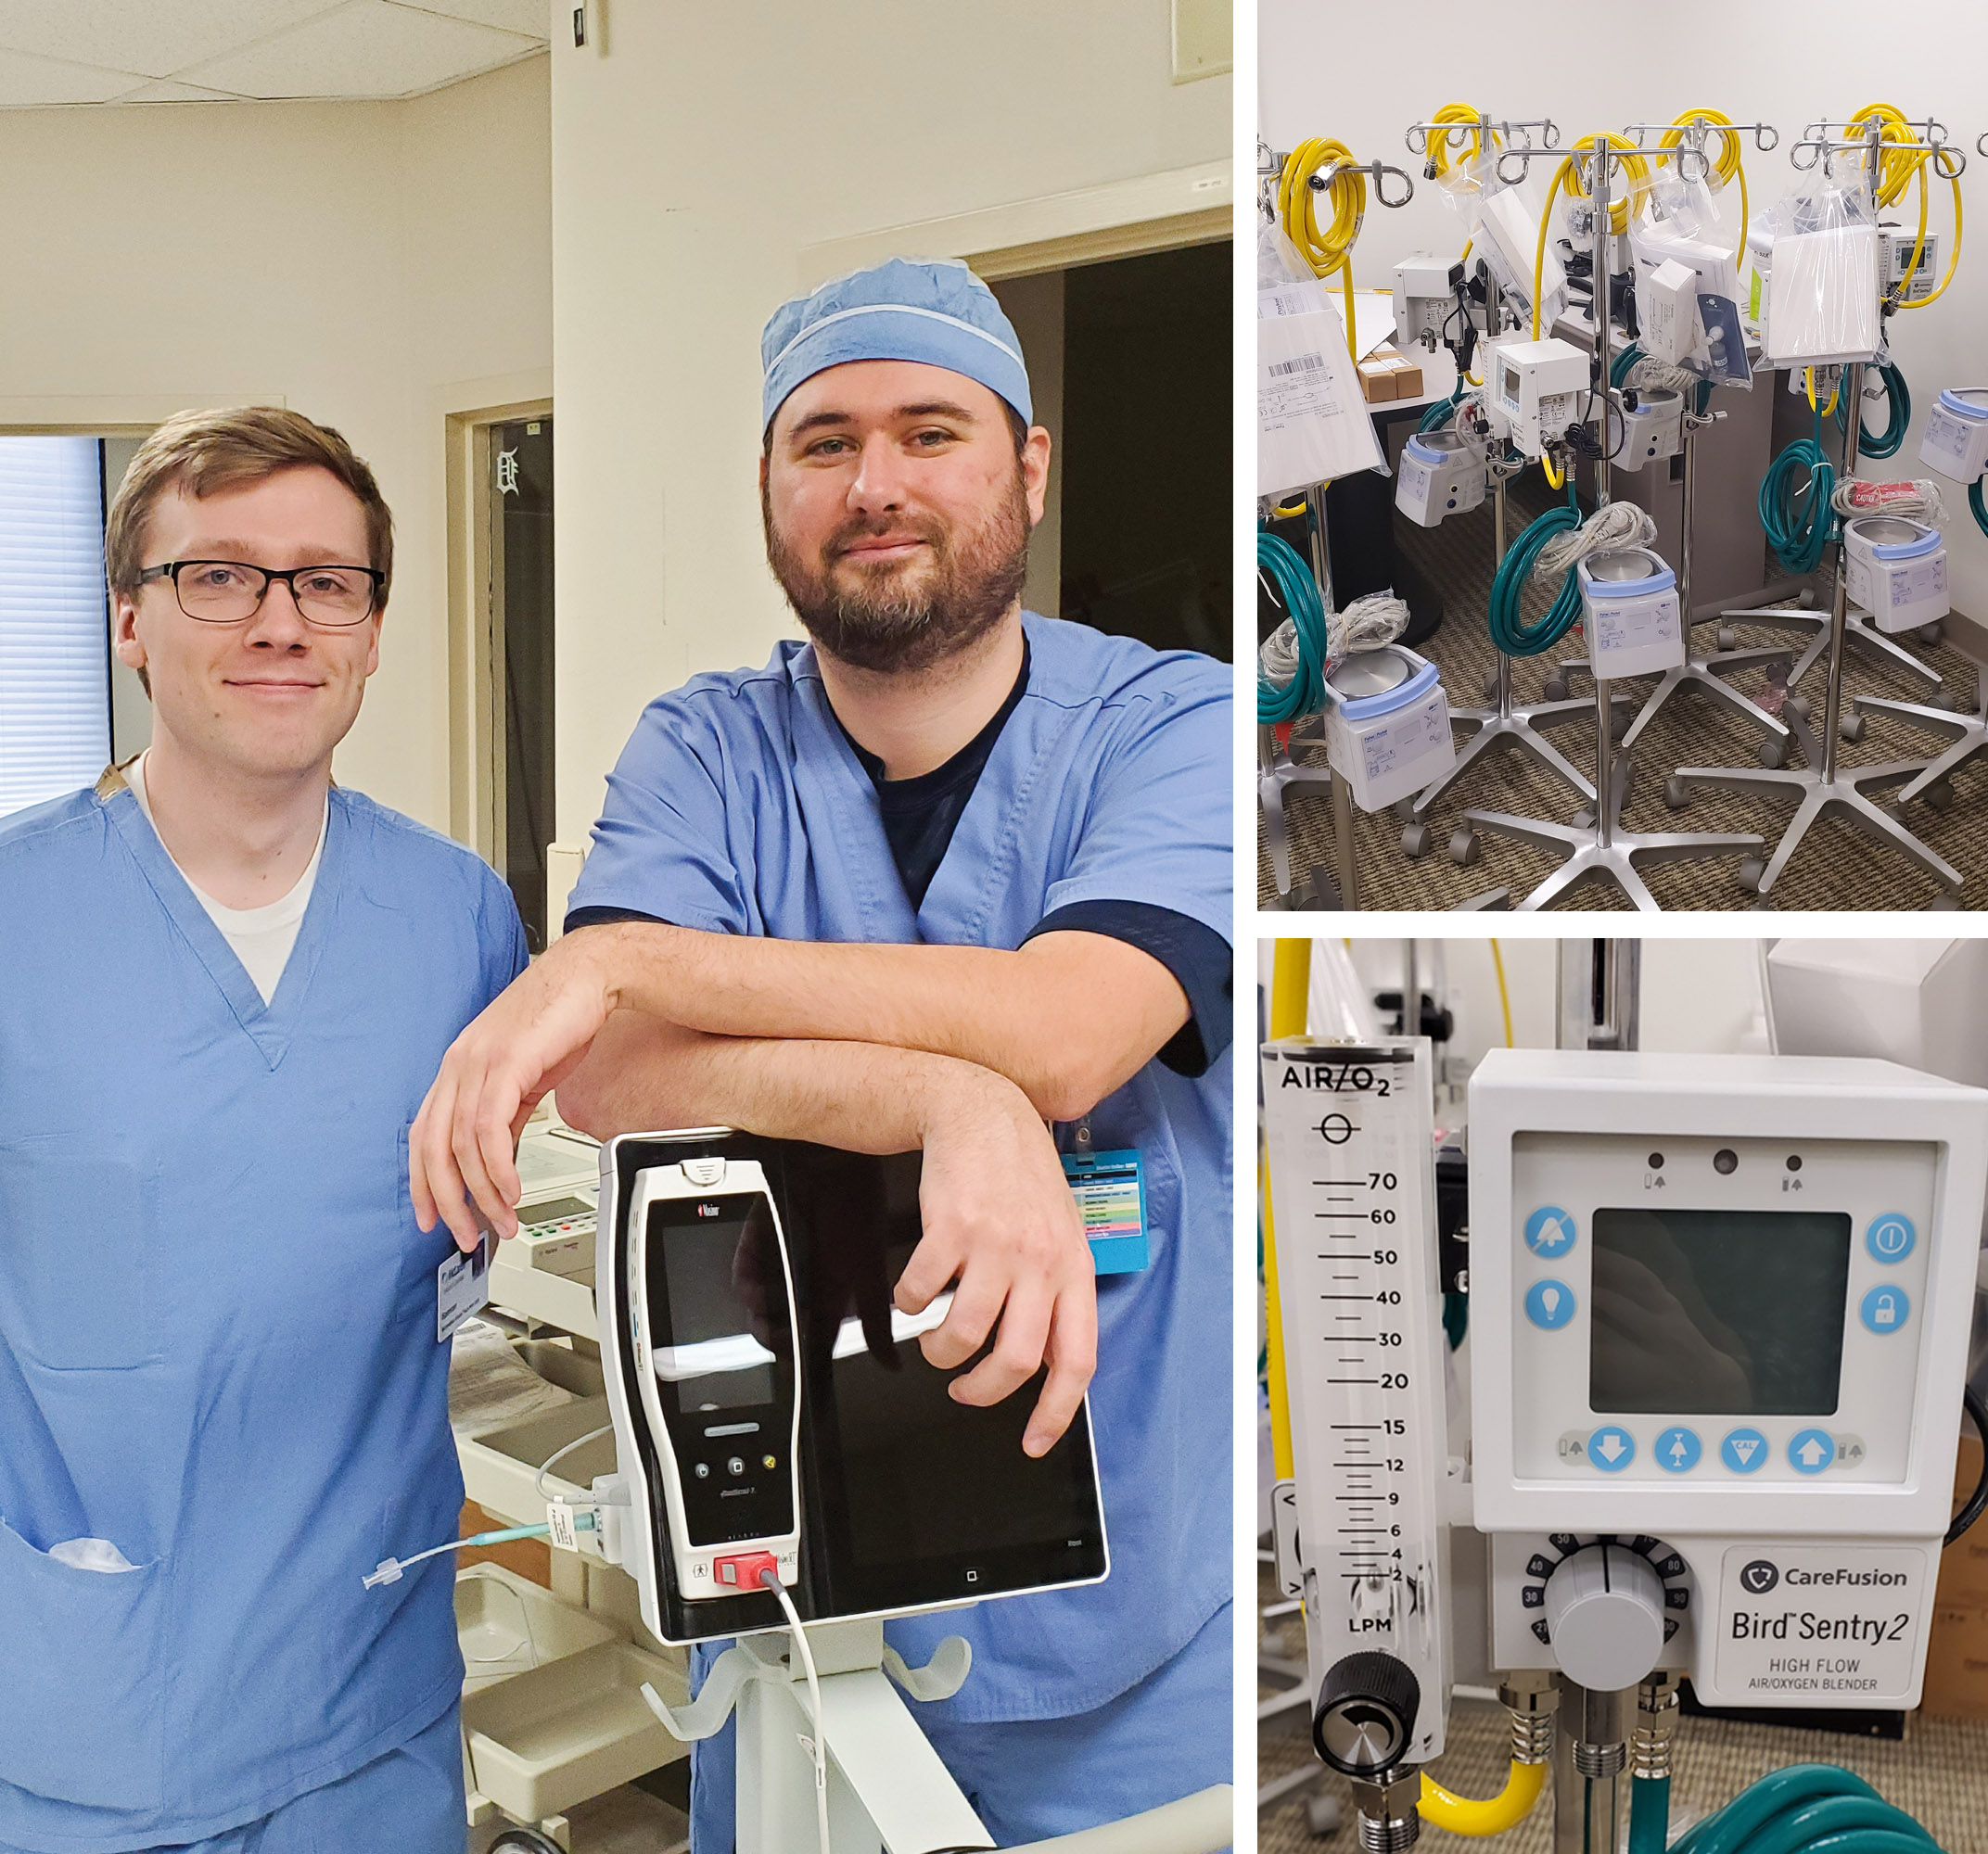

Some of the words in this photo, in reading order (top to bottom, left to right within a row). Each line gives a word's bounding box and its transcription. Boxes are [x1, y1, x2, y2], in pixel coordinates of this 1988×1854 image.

[1369, 1173, 1397, 1190] 70
[1370, 1209, 1396, 1225] 60
[1373, 1250, 1398, 1264] 50
[1376, 1290, 1401, 1305] 40
[1379, 1332, 1402, 1347] 30
[1381, 1373, 1408, 1390] 20
[1383, 1419, 1406, 1435] 15
[1736, 1441, 1753, 1450] CAL
[1386, 1458, 1404, 1472] 12
[1388, 1492, 1399, 1505] 9
[1391, 1524, 1401, 1537] 6
[1392, 1548, 1402, 1560] 4
[1531, 1560, 1543, 1571] 40
[1667, 1559, 1680, 1570] 80
[1785, 1568, 1907, 1586] CareFusion
[1525, 1591, 1537, 1603] 30
[1674, 1592, 1686, 1604] 90
[1348, 1618, 1392, 1632] LPM
[1769, 1657, 1810, 1673] HIGH
[1816, 1658, 1861, 1674] FLOW
[1748, 1677, 1818, 1690] AIR/OXYGEN
[1822, 1678, 1878, 1691] BLENDER
